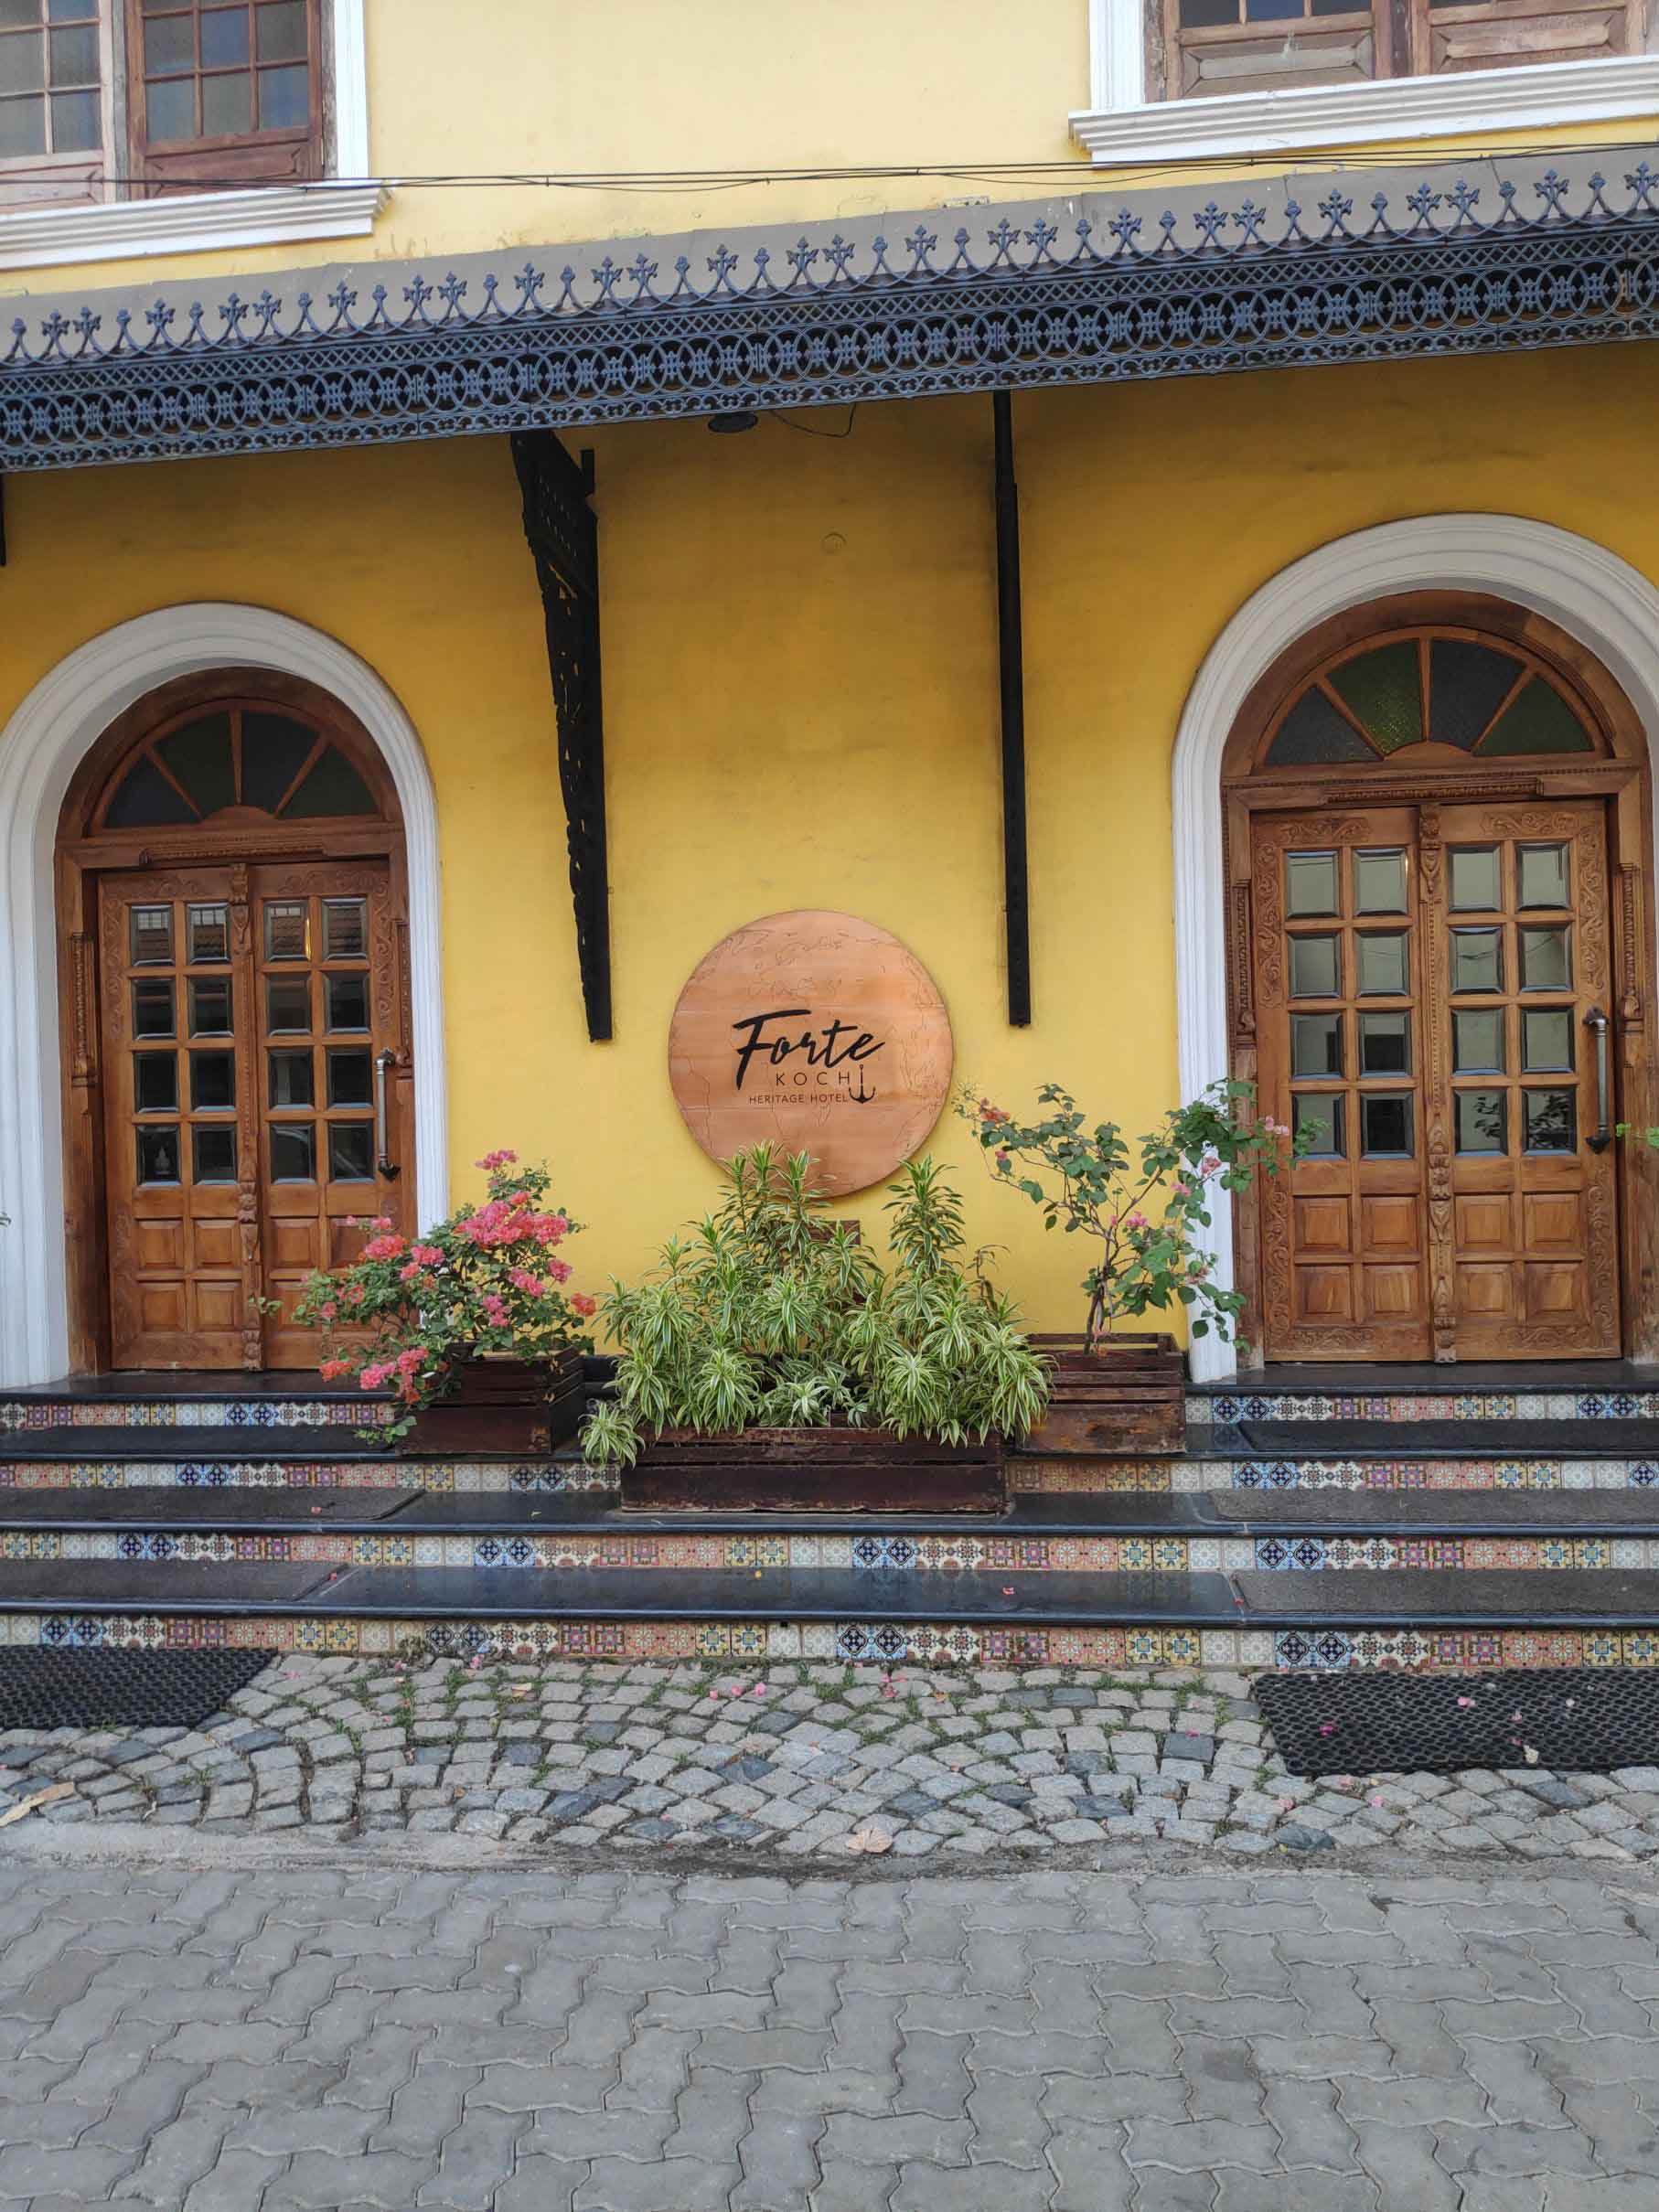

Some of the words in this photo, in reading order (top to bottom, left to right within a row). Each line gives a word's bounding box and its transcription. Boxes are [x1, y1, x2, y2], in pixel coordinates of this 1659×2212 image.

[732, 1009, 885, 1090] Forte
[748, 1094, 805, 1105] HERITAGE
[810, 1093, 849, 1104] HOTEL
